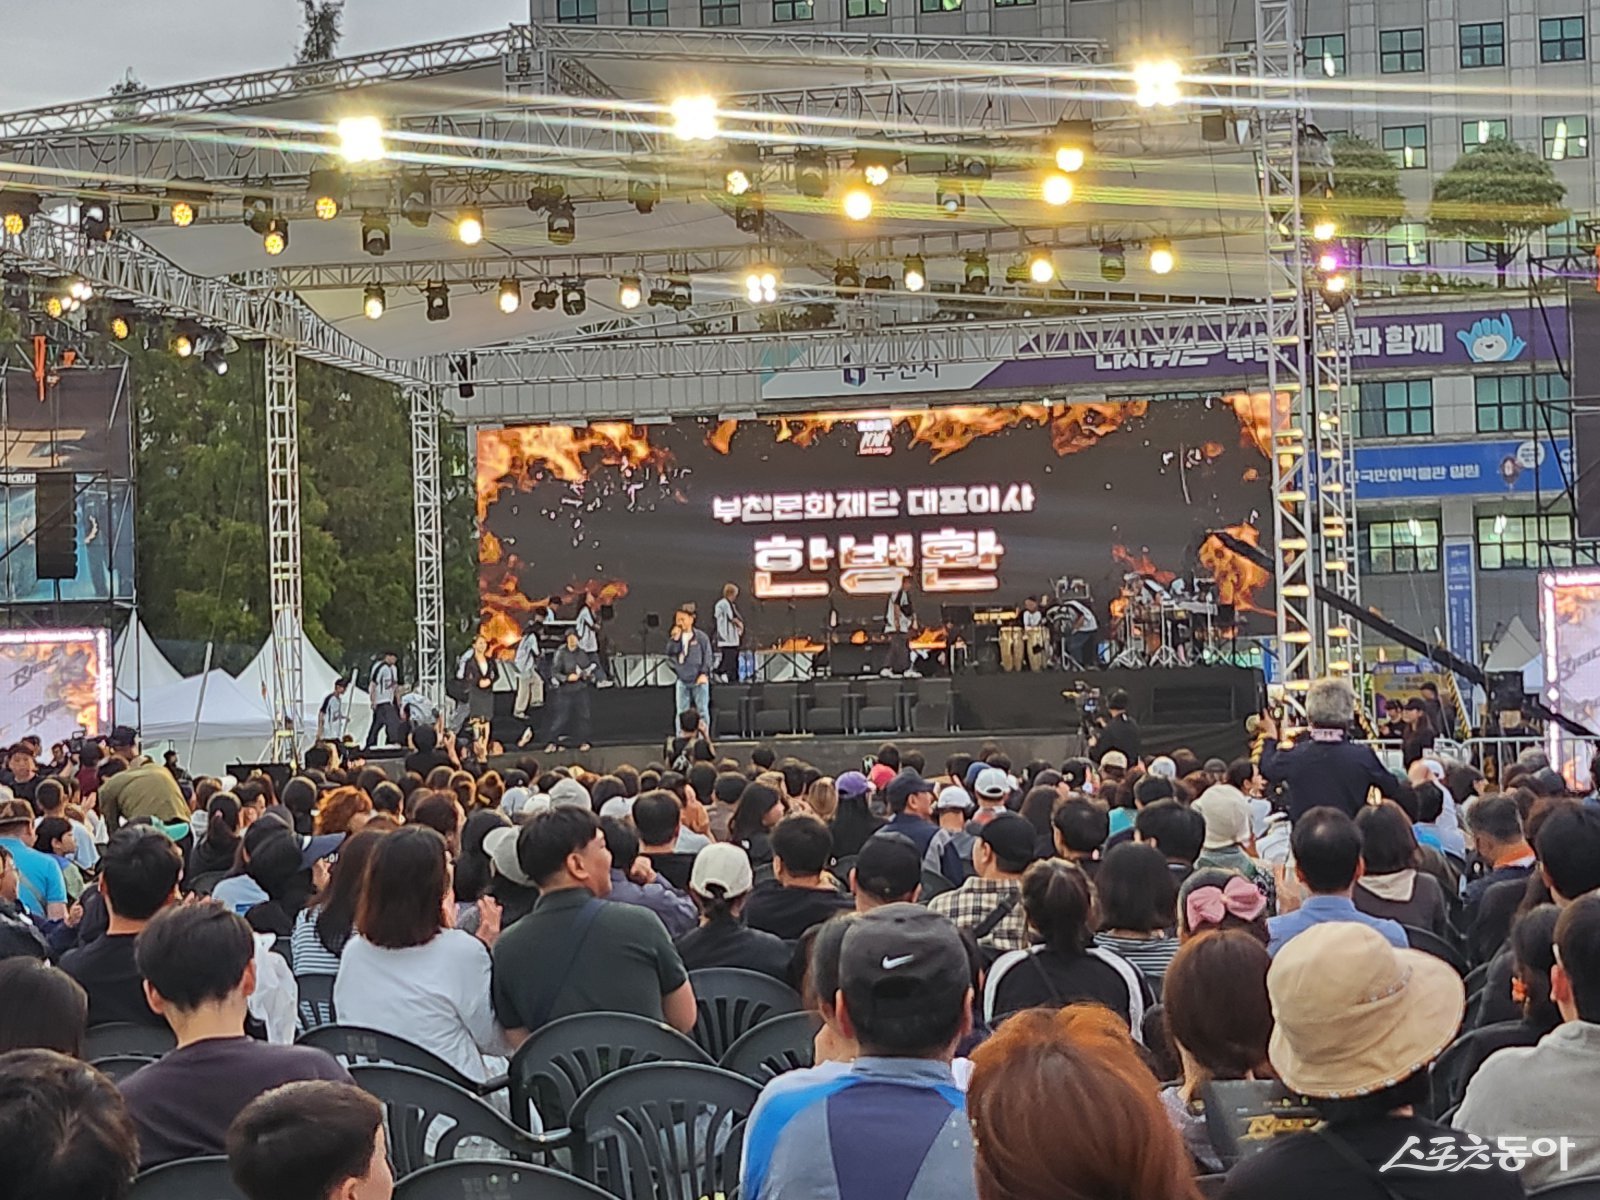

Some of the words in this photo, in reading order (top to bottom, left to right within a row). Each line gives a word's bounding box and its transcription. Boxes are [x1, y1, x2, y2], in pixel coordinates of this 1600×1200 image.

[1385, 323, 1445, 355] 함께
[713, 489, 901, 523] 부천문화재단
[907, 482, 1035, 516] 대표이사
[754, 528, 1004, 599] 한병환
